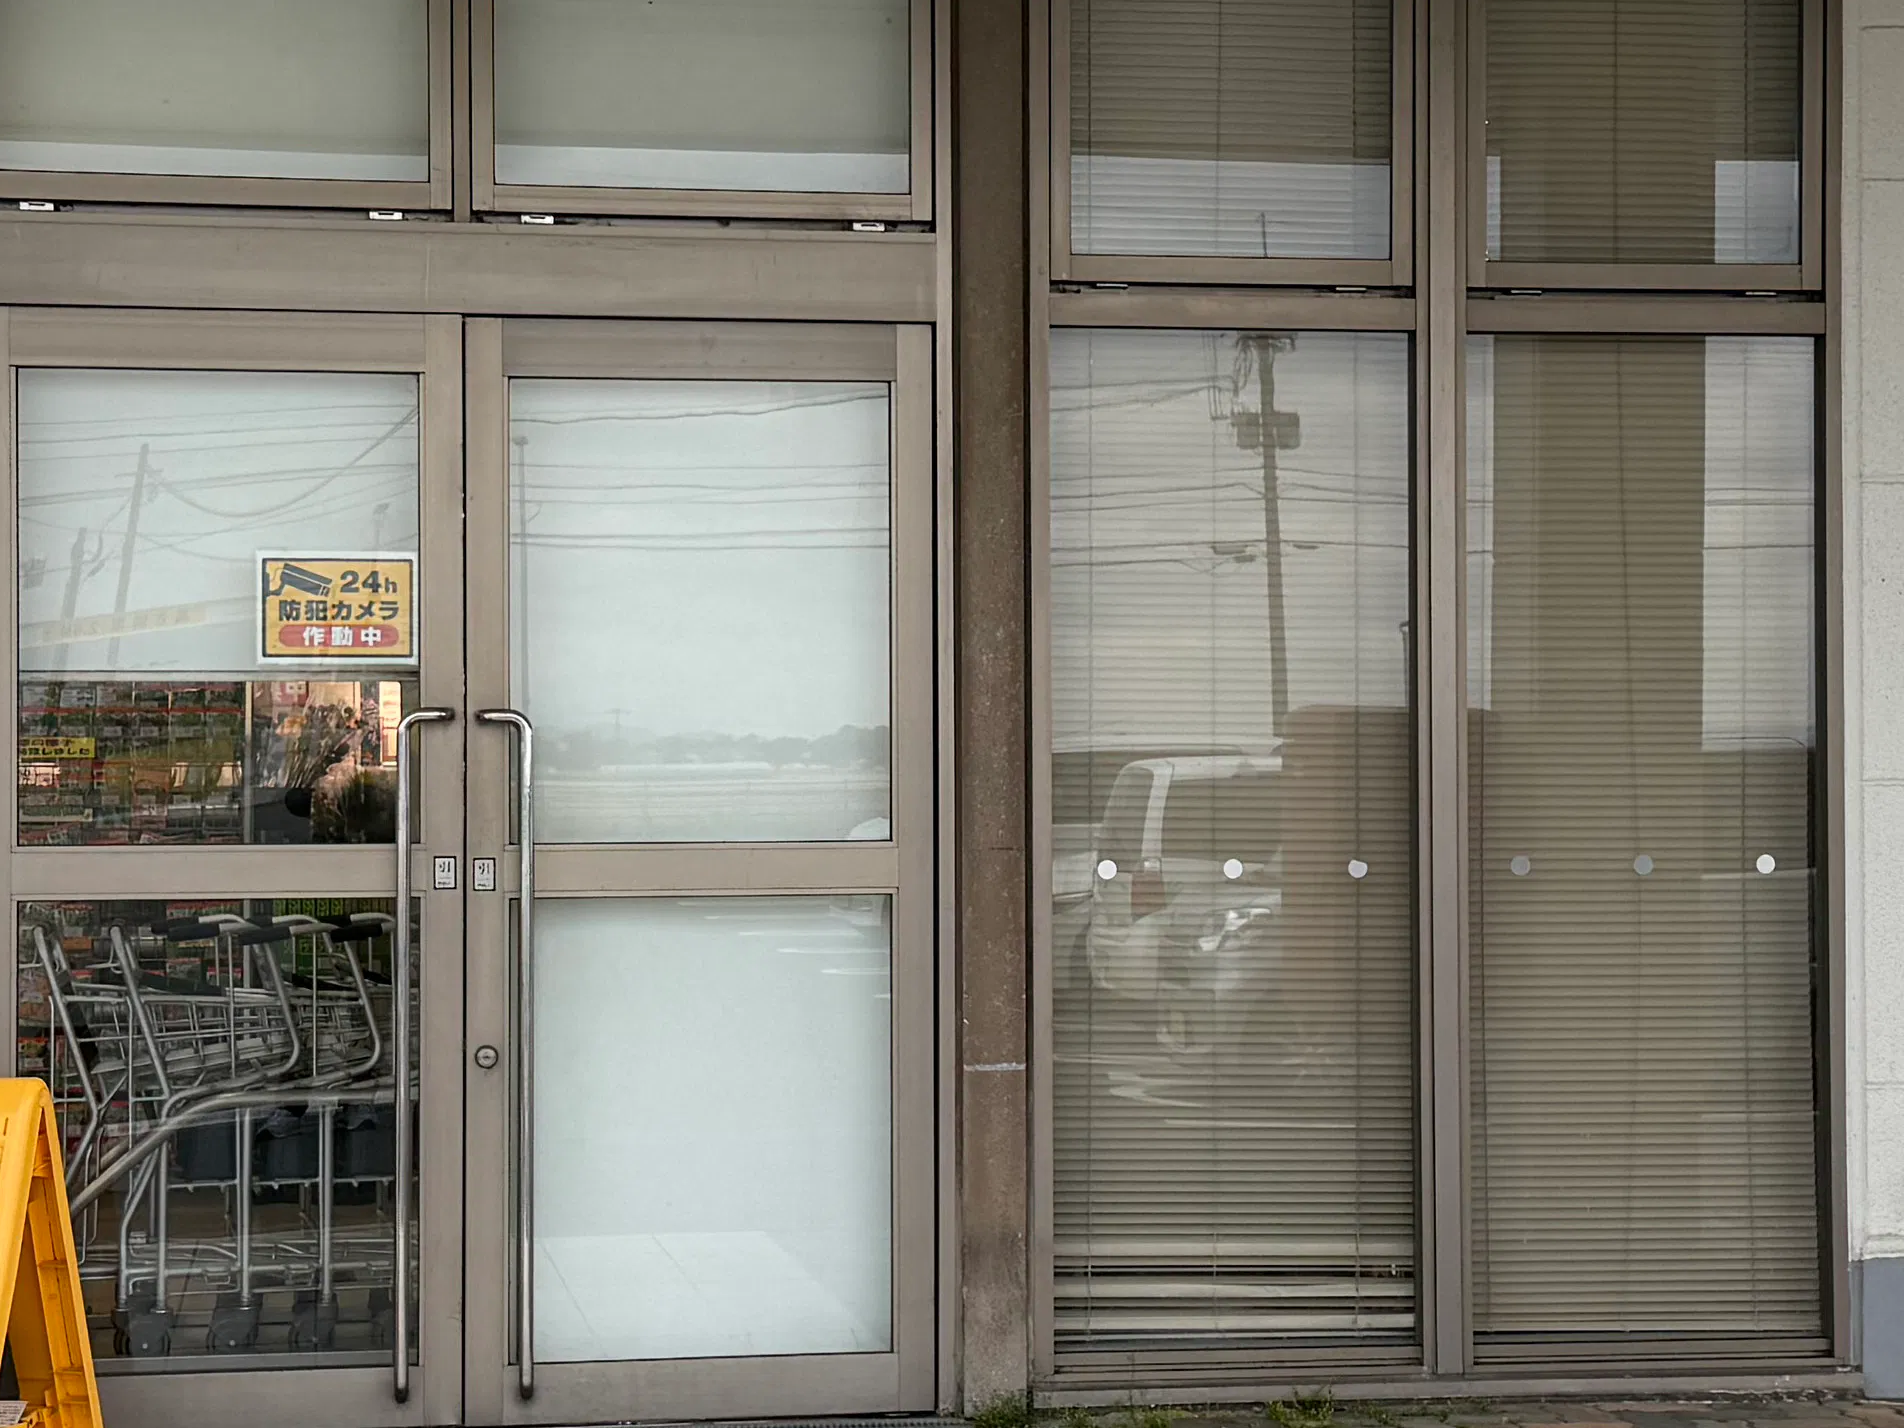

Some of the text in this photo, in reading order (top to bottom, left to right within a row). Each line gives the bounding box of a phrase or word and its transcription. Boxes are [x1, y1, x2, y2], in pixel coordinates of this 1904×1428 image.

[340, 570, 398, 593] 24h
[279, 600, 399, 621] 防犯カメラ
[303, 626, 382, 647] 作動中
